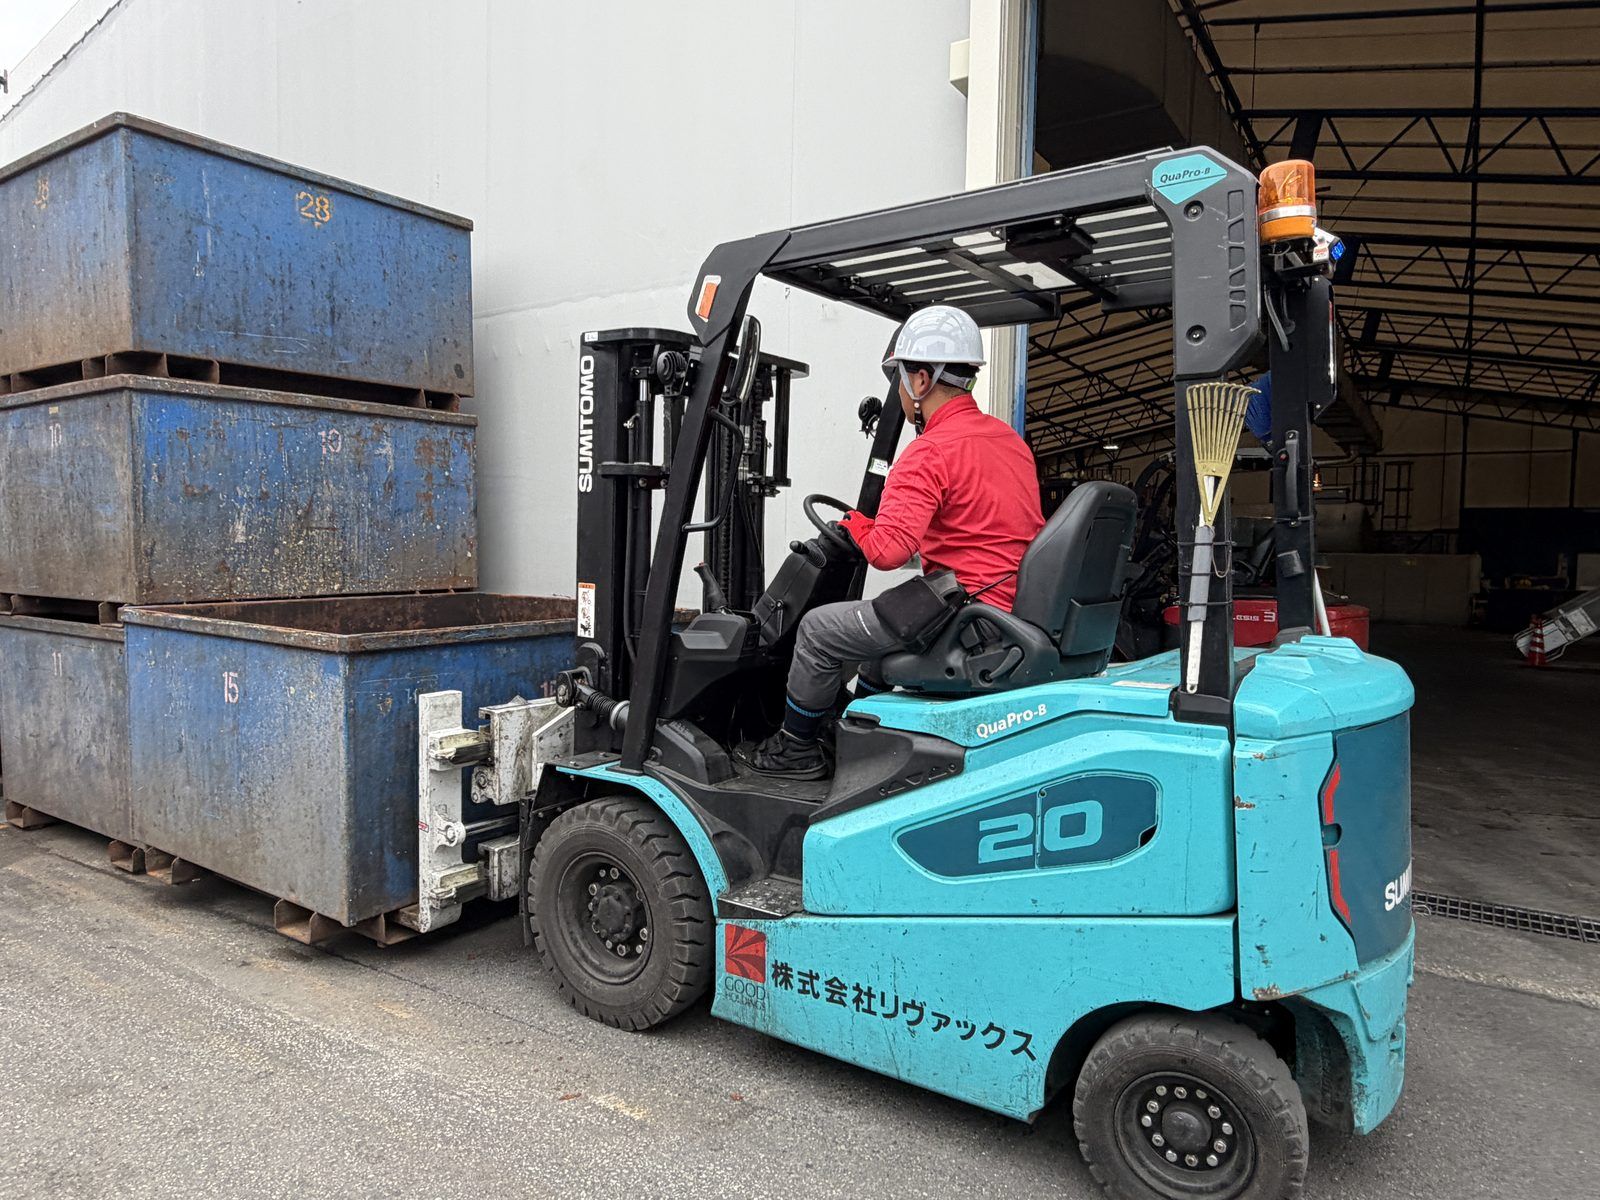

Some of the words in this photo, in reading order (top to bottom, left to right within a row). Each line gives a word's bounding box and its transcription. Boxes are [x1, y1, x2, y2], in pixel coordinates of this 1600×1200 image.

[1160, 167, 1211, 183] QuaPro-B
[296, 191, 331, 222] 28
[49, 423, 62, 447] 10
[578, 355, 595, 493] SUMITOMO
[318, 428, 342, 454] 10
[1263, 611, 1276, 623] 3
[52, 651, 63, 677] 11
[222, 671, 239, 704] 15
[976, 703, 1047, 739] QuaPro-B
[978, 800, 1103, 864] 20
[724, 976, 766, 1000] GOOD
[771, 959, 1037, 1062] 株式会社リヴァックス
